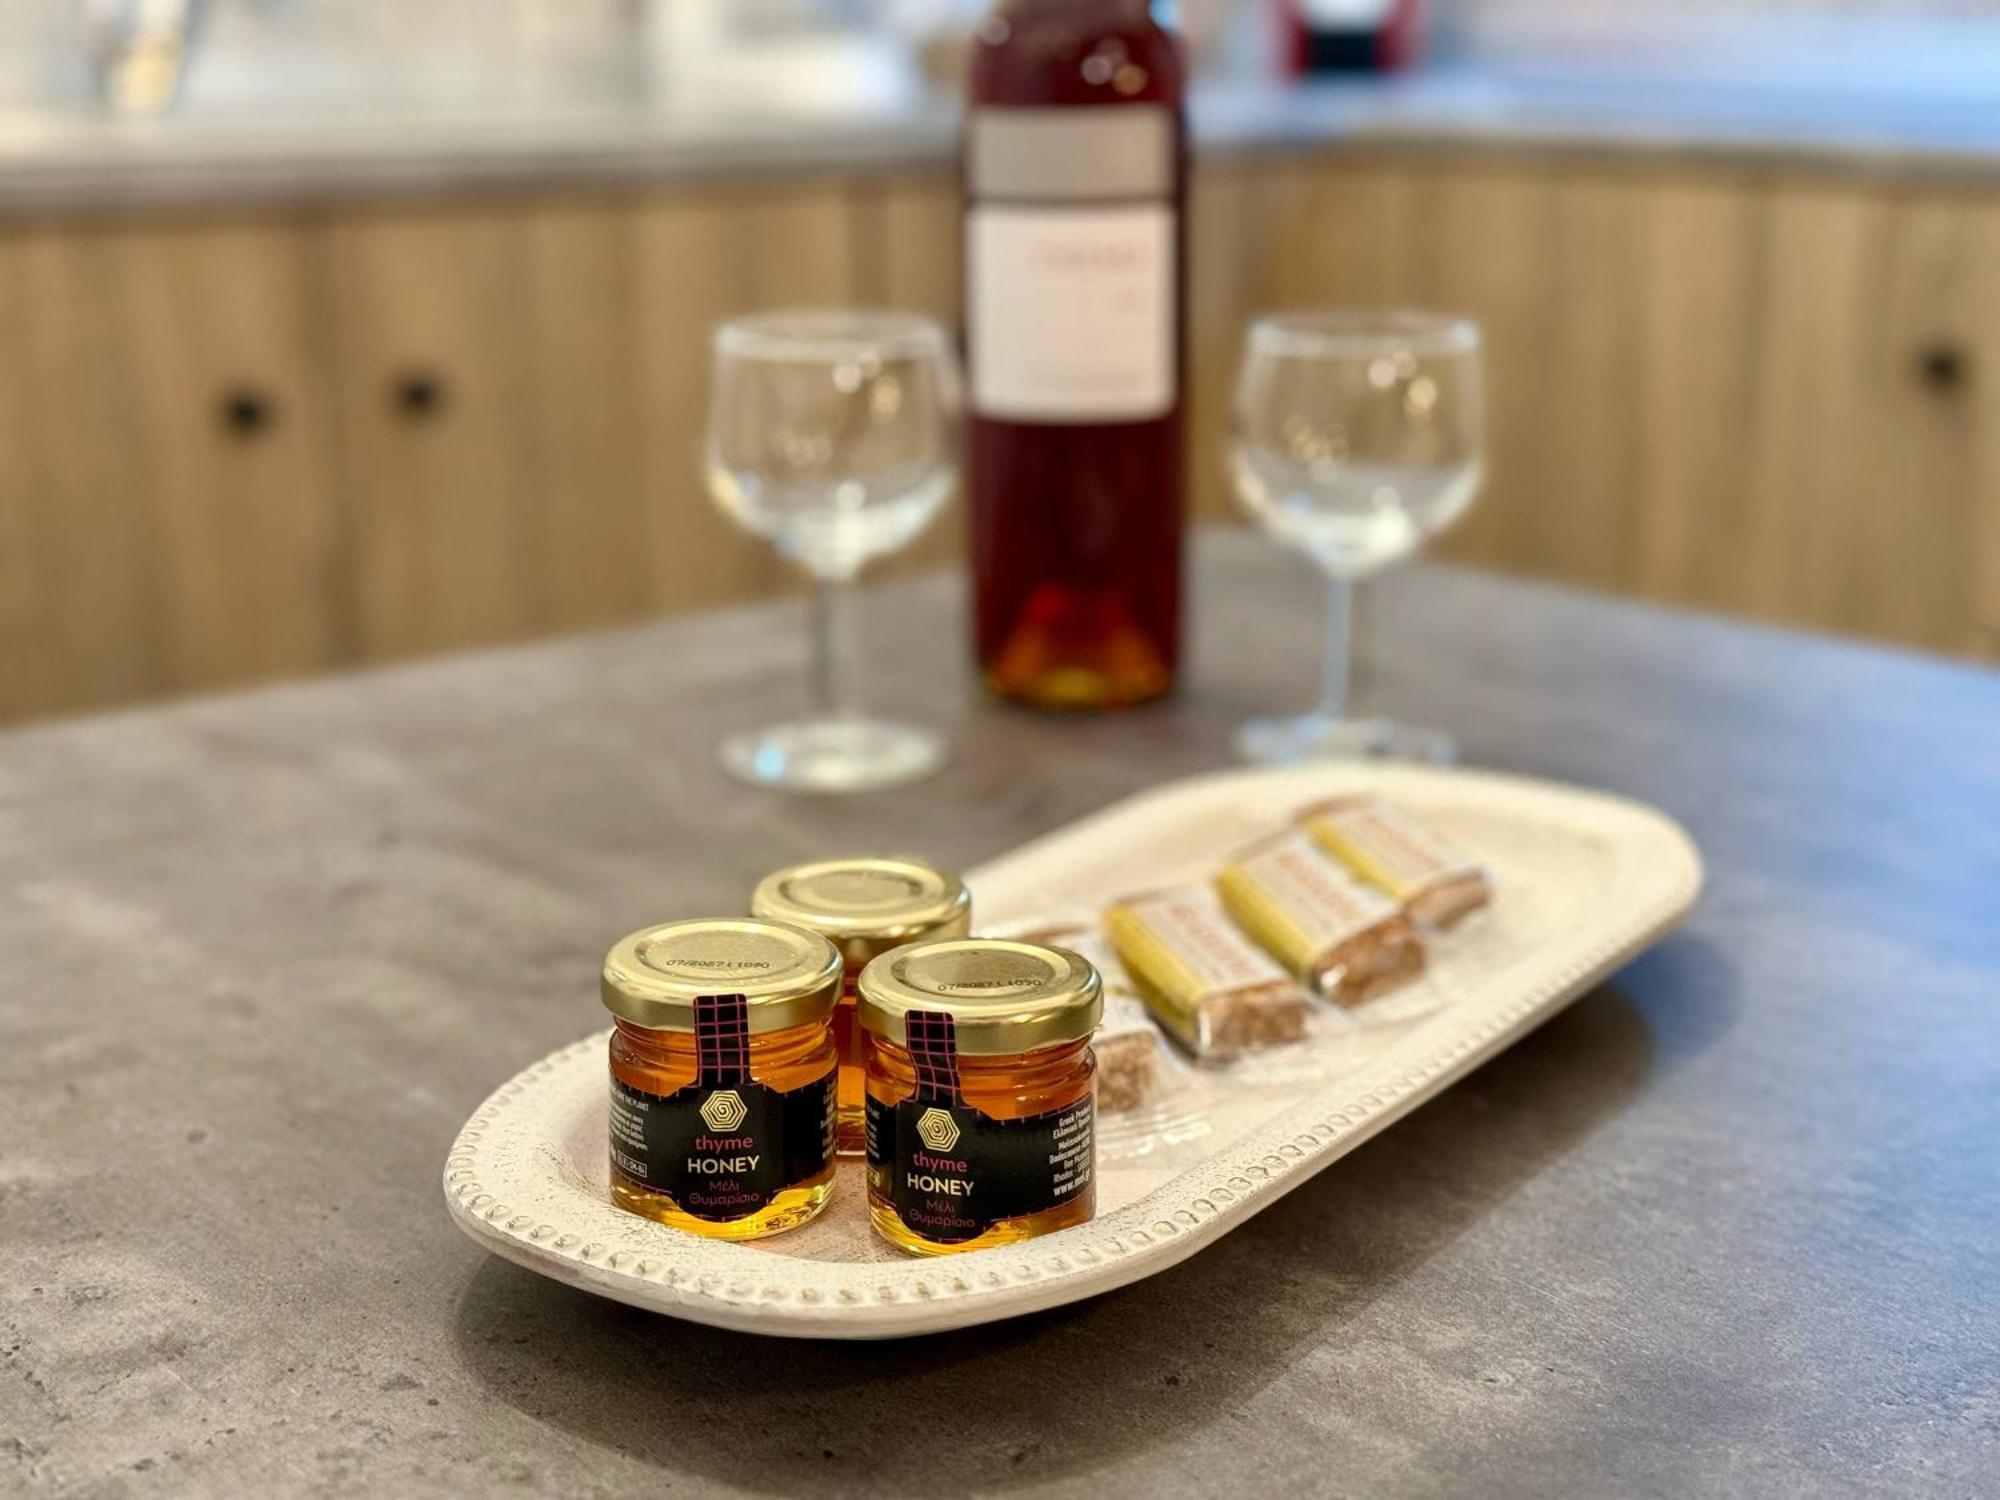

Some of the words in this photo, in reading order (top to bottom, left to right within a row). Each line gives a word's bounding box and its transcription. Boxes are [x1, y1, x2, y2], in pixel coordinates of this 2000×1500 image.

[695, 1134, 754, 1154] thyme
[687, 1154, 760, 1174] HONEY
[913, 1150, 968, 1173] thyme
[907, 1172, 975, 1197] HONEY
